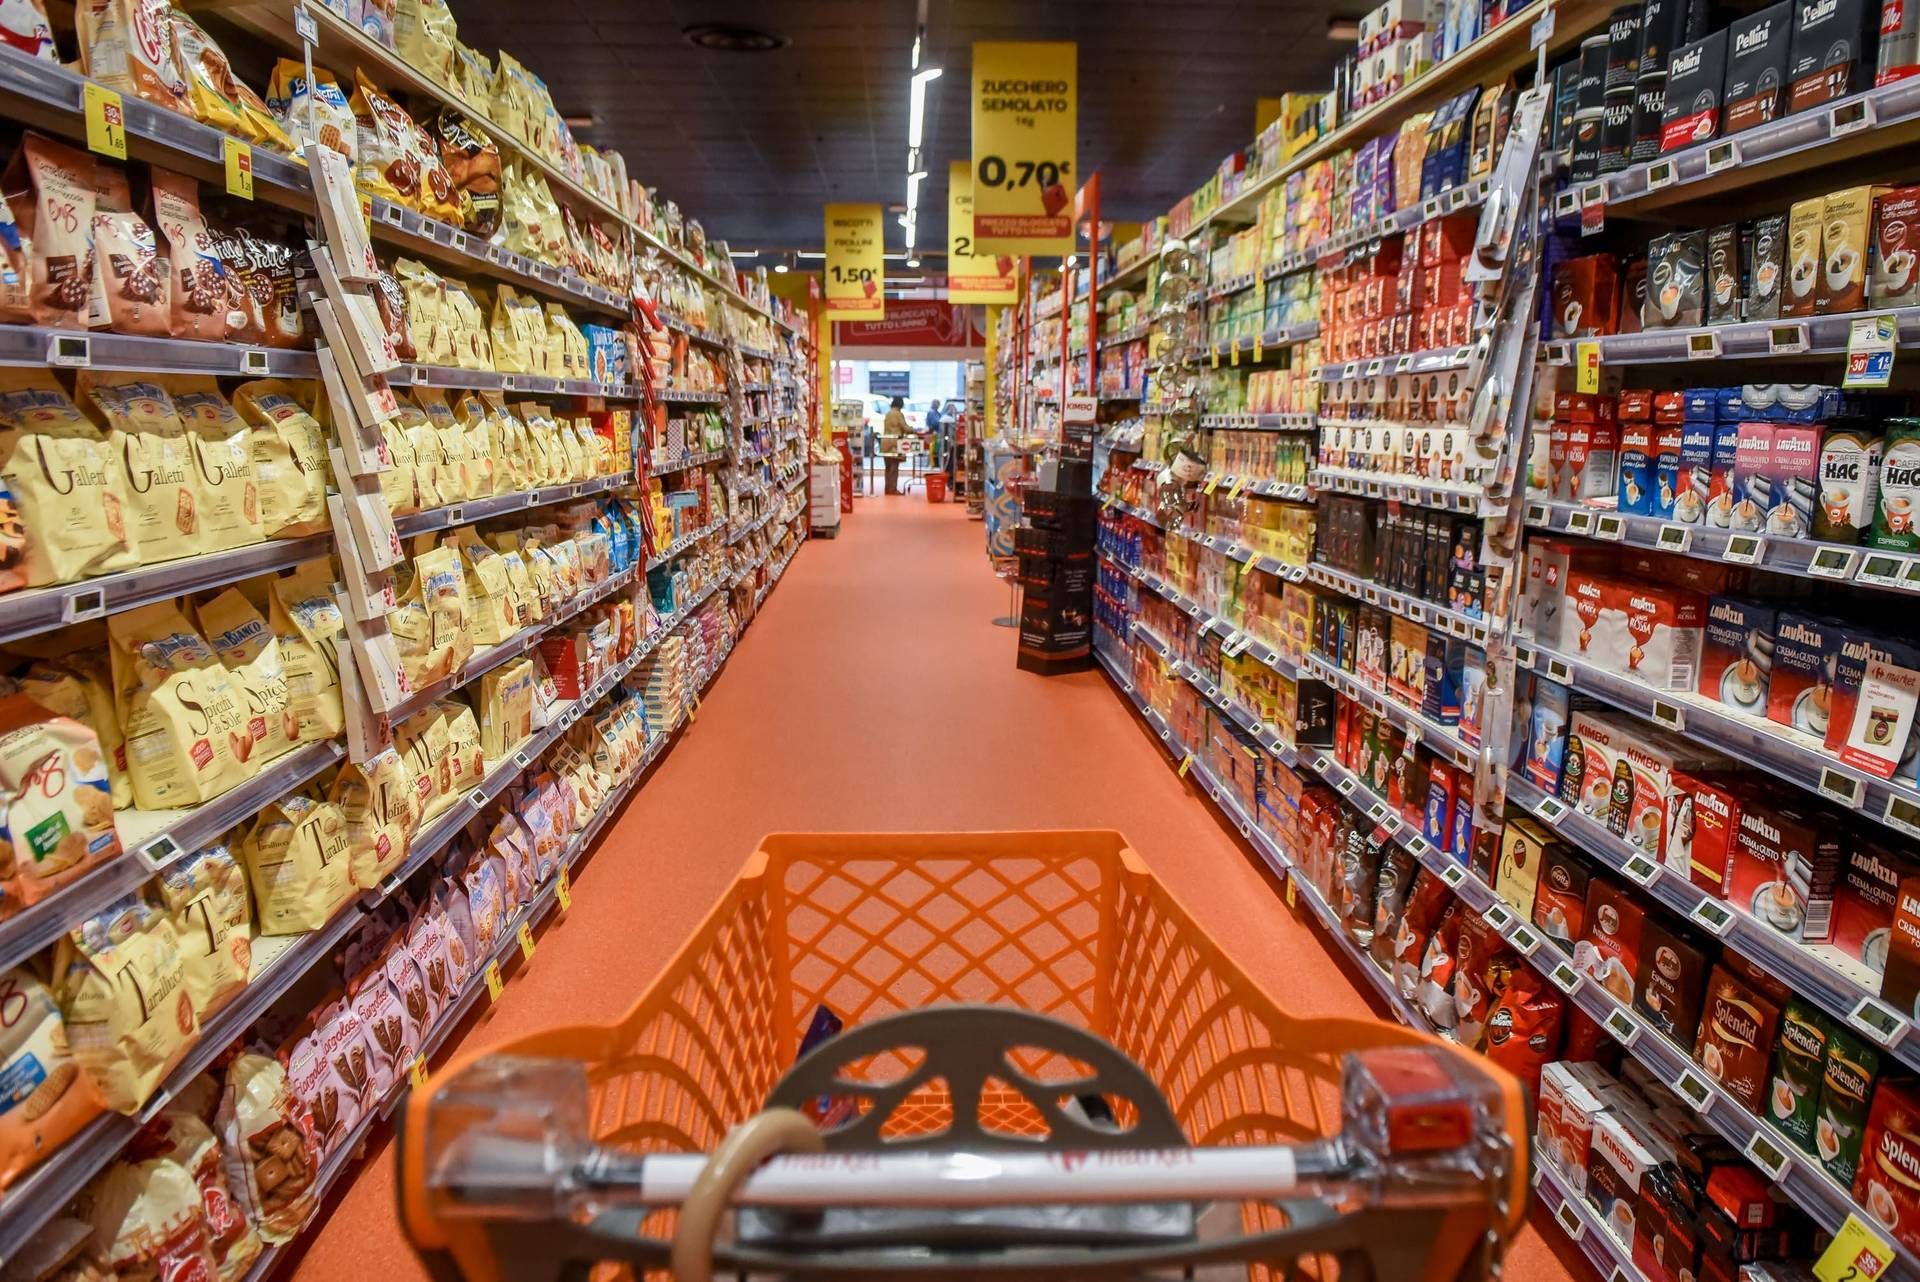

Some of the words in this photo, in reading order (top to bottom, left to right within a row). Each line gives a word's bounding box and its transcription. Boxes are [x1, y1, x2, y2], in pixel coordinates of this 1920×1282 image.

[1612, 30, 1632, 42] TOP
[1735, 20, 1771, 52] Pellini
[1671, 46, 1703, 77] Pellini
[980, 80, 1068, 94] ZUCCHERO
[980, 99, 1068, 113] SEMOLATO
[1607, 114, 1628, 127] TOP
[1067, 403, 1093, 412] KIMBO
[1623, 432, 1649, 446] LAVAZZA
[1684, 431, 1710, 446] LAVAZZA
[1738, 436, 1770, 452] LAVAZZA
[1776, 436, 1811, 452] LAVAZZA
[34, 432, 108, 495] Galletti
[123, 432, 185, 494] Galletti
[195, 435, 250, 486] Galletti
[1825, 465, 1858, 483] HAG
[1877, 538, 1909, 549] ESPRESSO
[1630, 597, 1656, 614] LAVAZZA
[1710, 604, 1744, 626] LAVAZZA
[224, 620, 262, 646] BIANCO
[1629, 618, 1651, 635] ROSSA
[1779, 624, 1821, 648] LAVAZZA
[1798, 651, 1820, 666] GUSTO
[175, 679, 235, 736] Spicchi
[1577, 723, 1610, 746] KIMBO
[1627, 747, 1662, 774] KIMBO
[1694, 790, 1729, 819] LAVAZZA
[1741, 813, 1781, 844] LAVAZZA
[1748, 848, 1766, 862] RICCO
[1758, 844, 1779, 862] GUSTO
[1849, 851, 1898, 888] LAVAZZA
[1859, 890, 1880, 906] RICCO
[1871, 886, 1896, 906] GUSTO
[1714, 1000, 1757, 1044] Splendid
[1783, 1021, 1820, 1058] Splendid
[1825, 1058, 1865, 1097] Splendid
[1563, 1098, 1587, 1125] KIMBO
[1600, 1132, 1635, 1173] KIMBO
